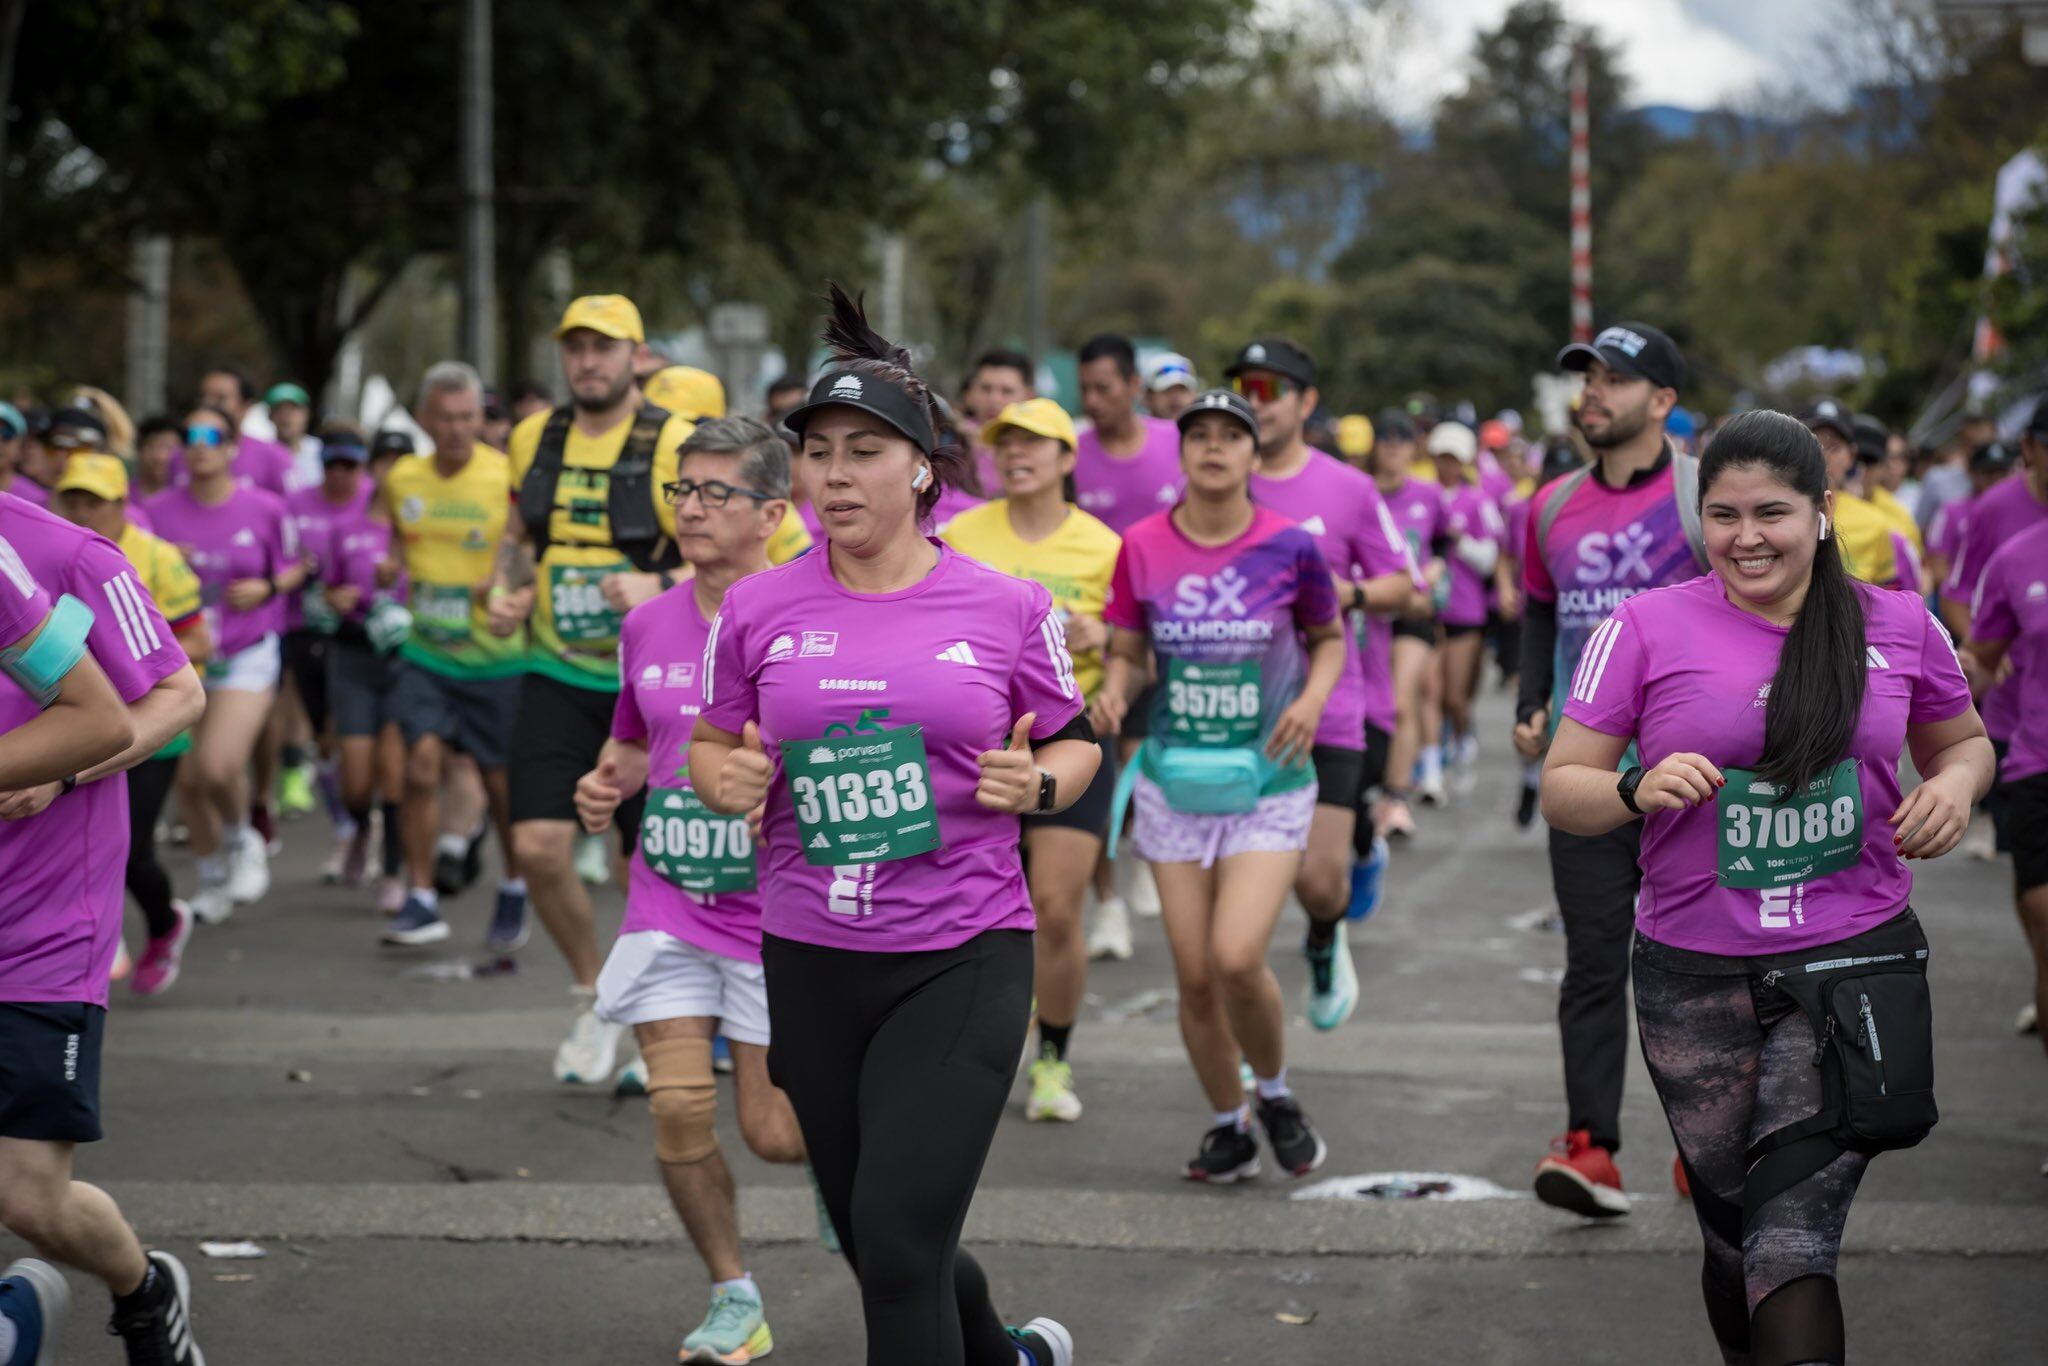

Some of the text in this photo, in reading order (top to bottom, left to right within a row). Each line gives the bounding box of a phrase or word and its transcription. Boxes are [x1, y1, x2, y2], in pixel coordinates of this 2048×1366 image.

[818, 679, 888, 691] SAMSUNG
[1168, 679, 1260, 720] 35756
[838, 741, 893, 761] porvenir
[793, 762, 927, 824] 31333
[644, 814, 752, 859] 30970
[1726, 796, 1855, 849] 37088
[1823, 844, 1854, 857] SAMSUNG
[64, 1034, 79, 1080] adidas
